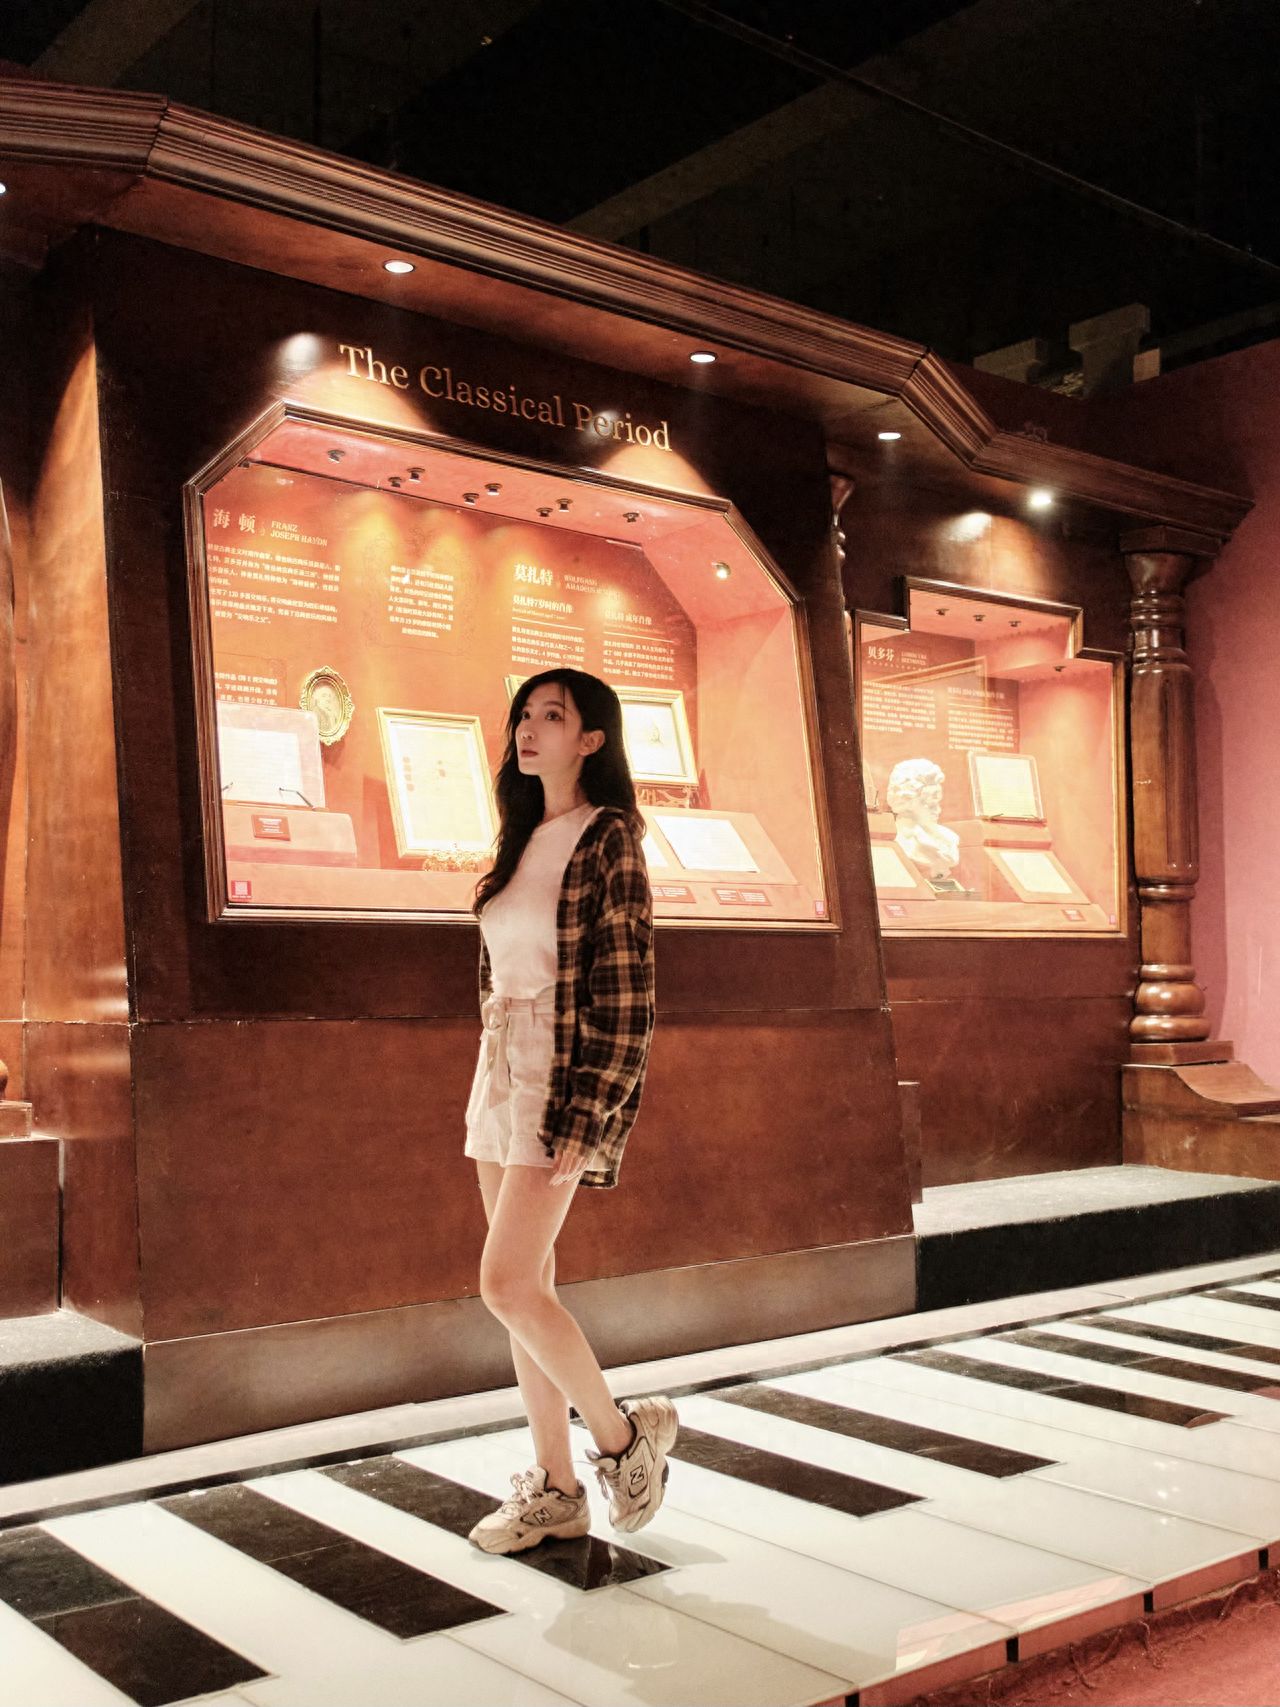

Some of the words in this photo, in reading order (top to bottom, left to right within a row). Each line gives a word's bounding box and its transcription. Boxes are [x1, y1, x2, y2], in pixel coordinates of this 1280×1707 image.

[339, 343, 410, 389] The
[419, 365, 566, 428] Classical
[571, 402, 673, 452] Period
[213, 508, 256, 534] 海顿
[271, 520, 298, 533] FRANZ
[270, 529, 300, 543] JOSEPH
[301, 535, 328, 547] HAYDN
[868, 646, 895, 662] 贝多芬
